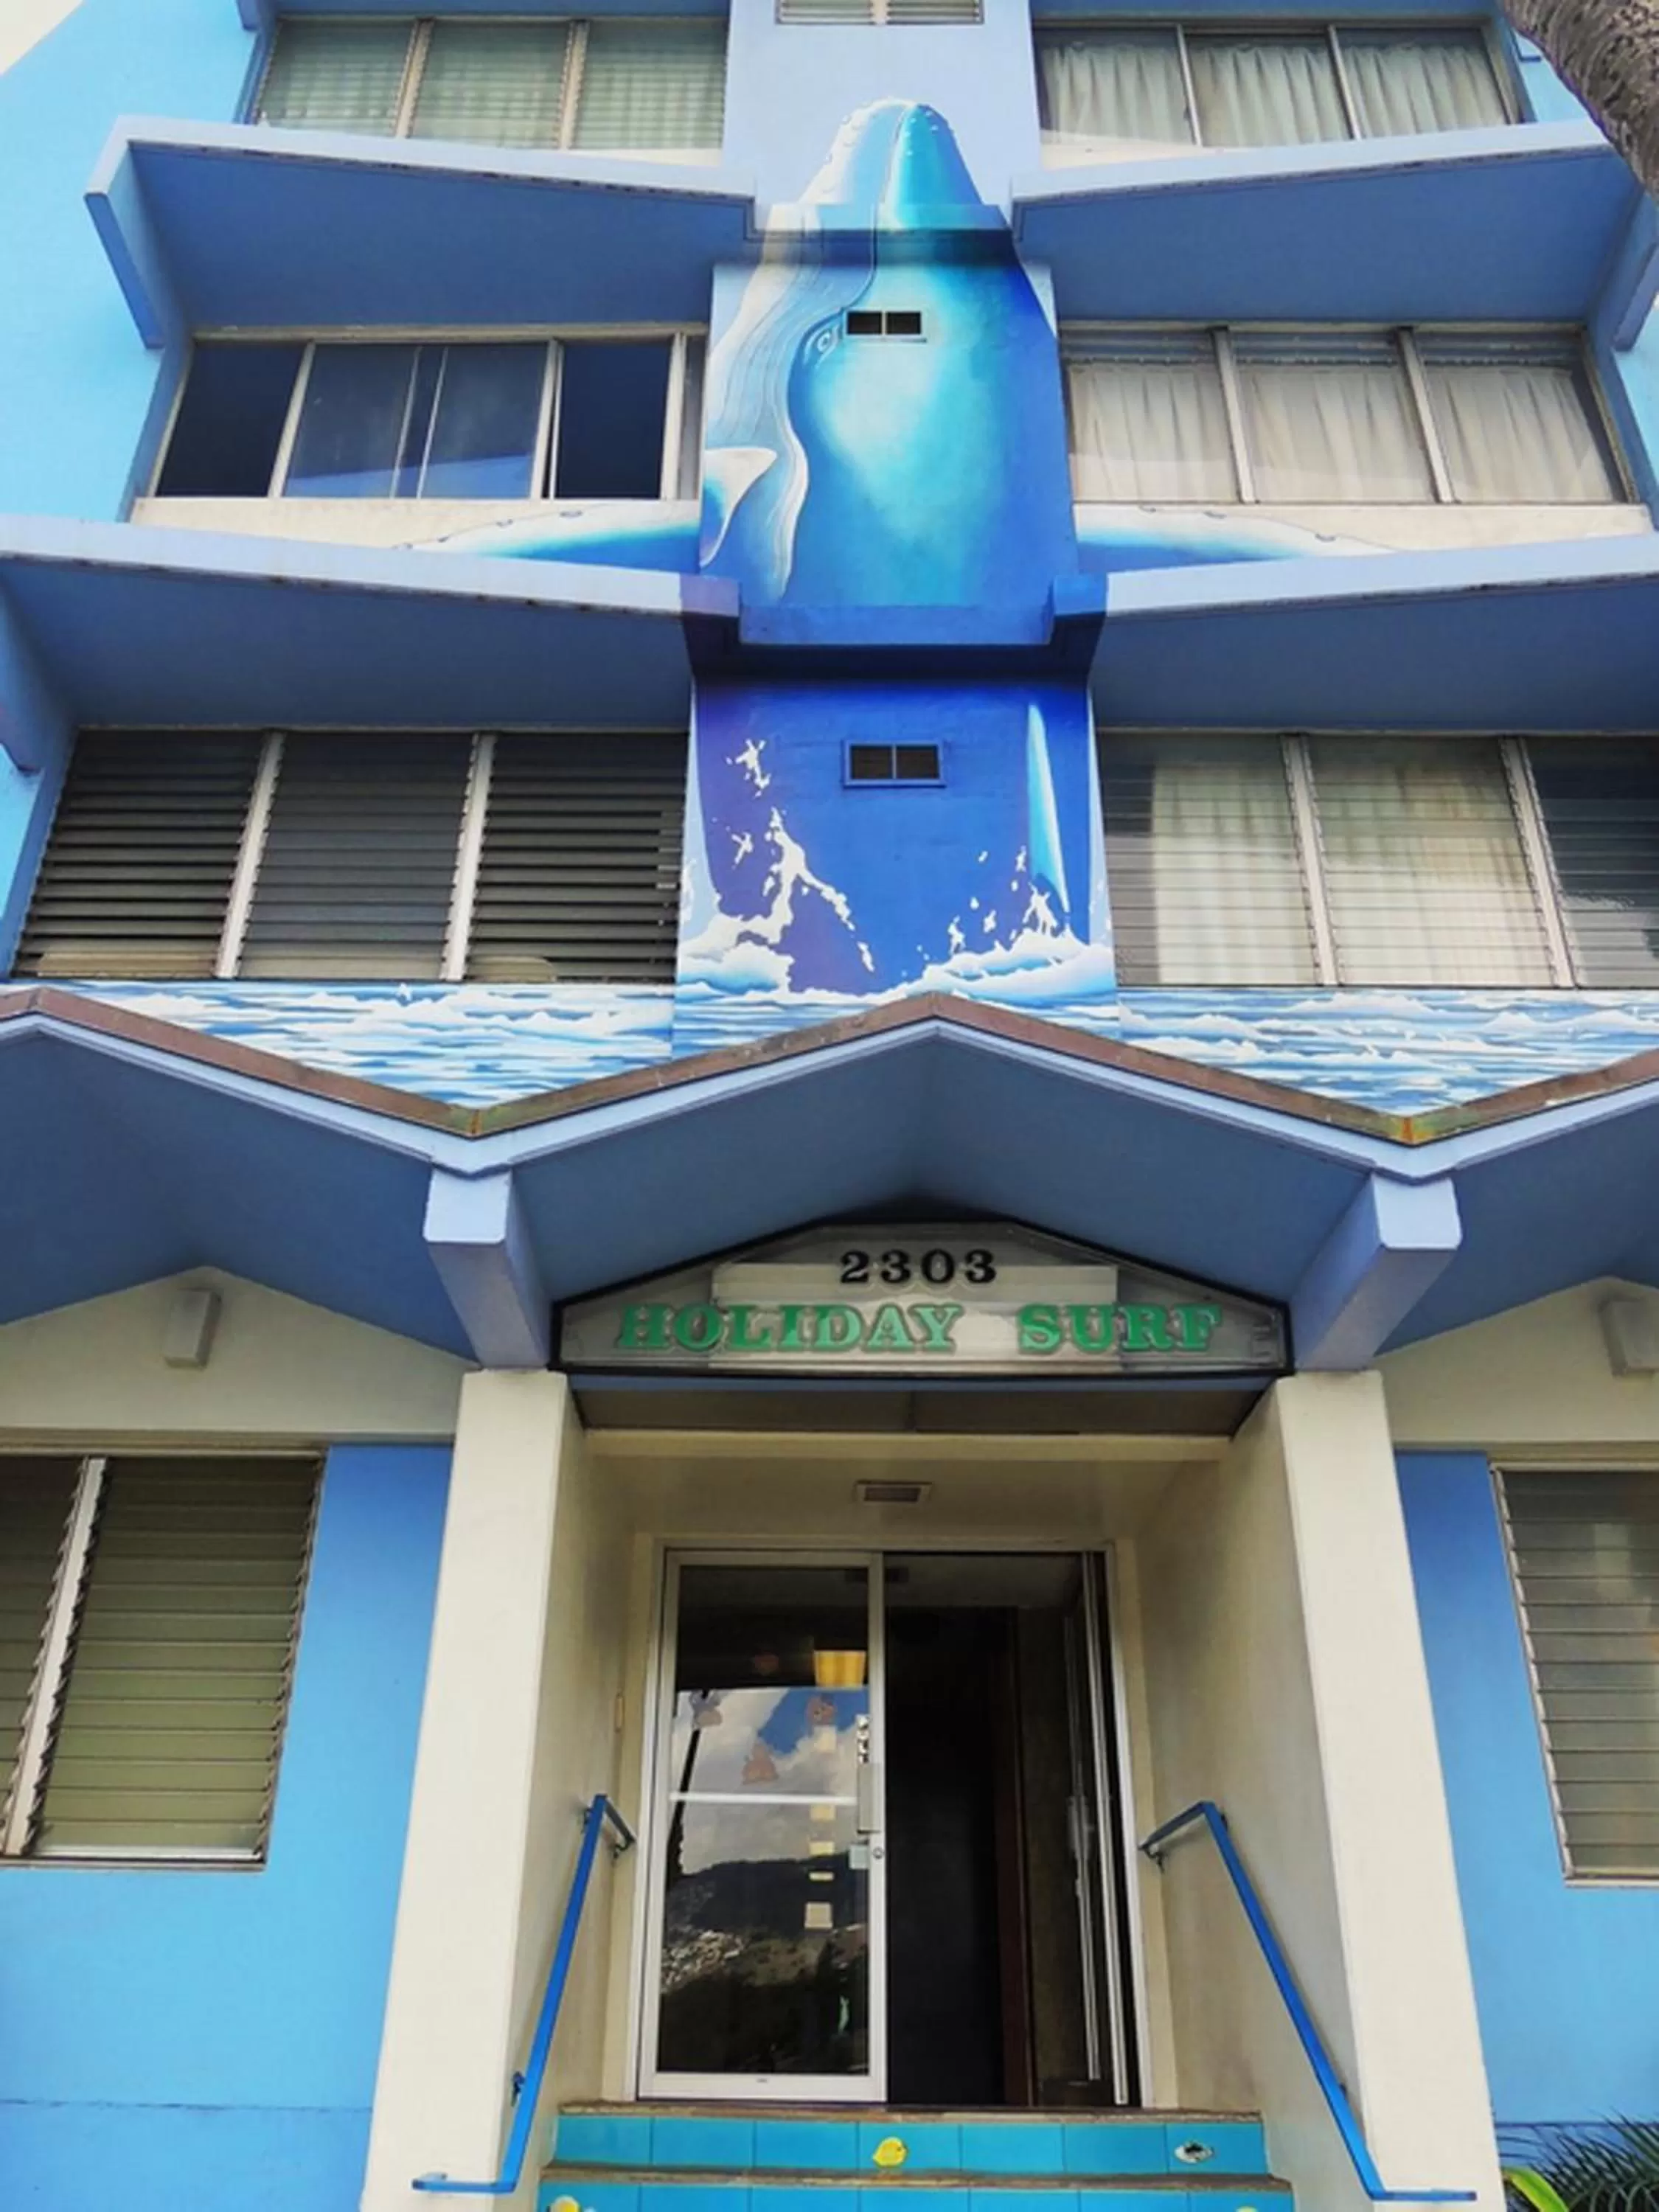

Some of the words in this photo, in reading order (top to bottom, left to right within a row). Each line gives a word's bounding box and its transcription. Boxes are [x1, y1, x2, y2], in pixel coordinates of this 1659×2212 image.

[840, 1248, 997, 1284] 2303
[616, 1302, 964, 1352] HOLIDAY
[1016, 1302, 1222, 1354] SURF
